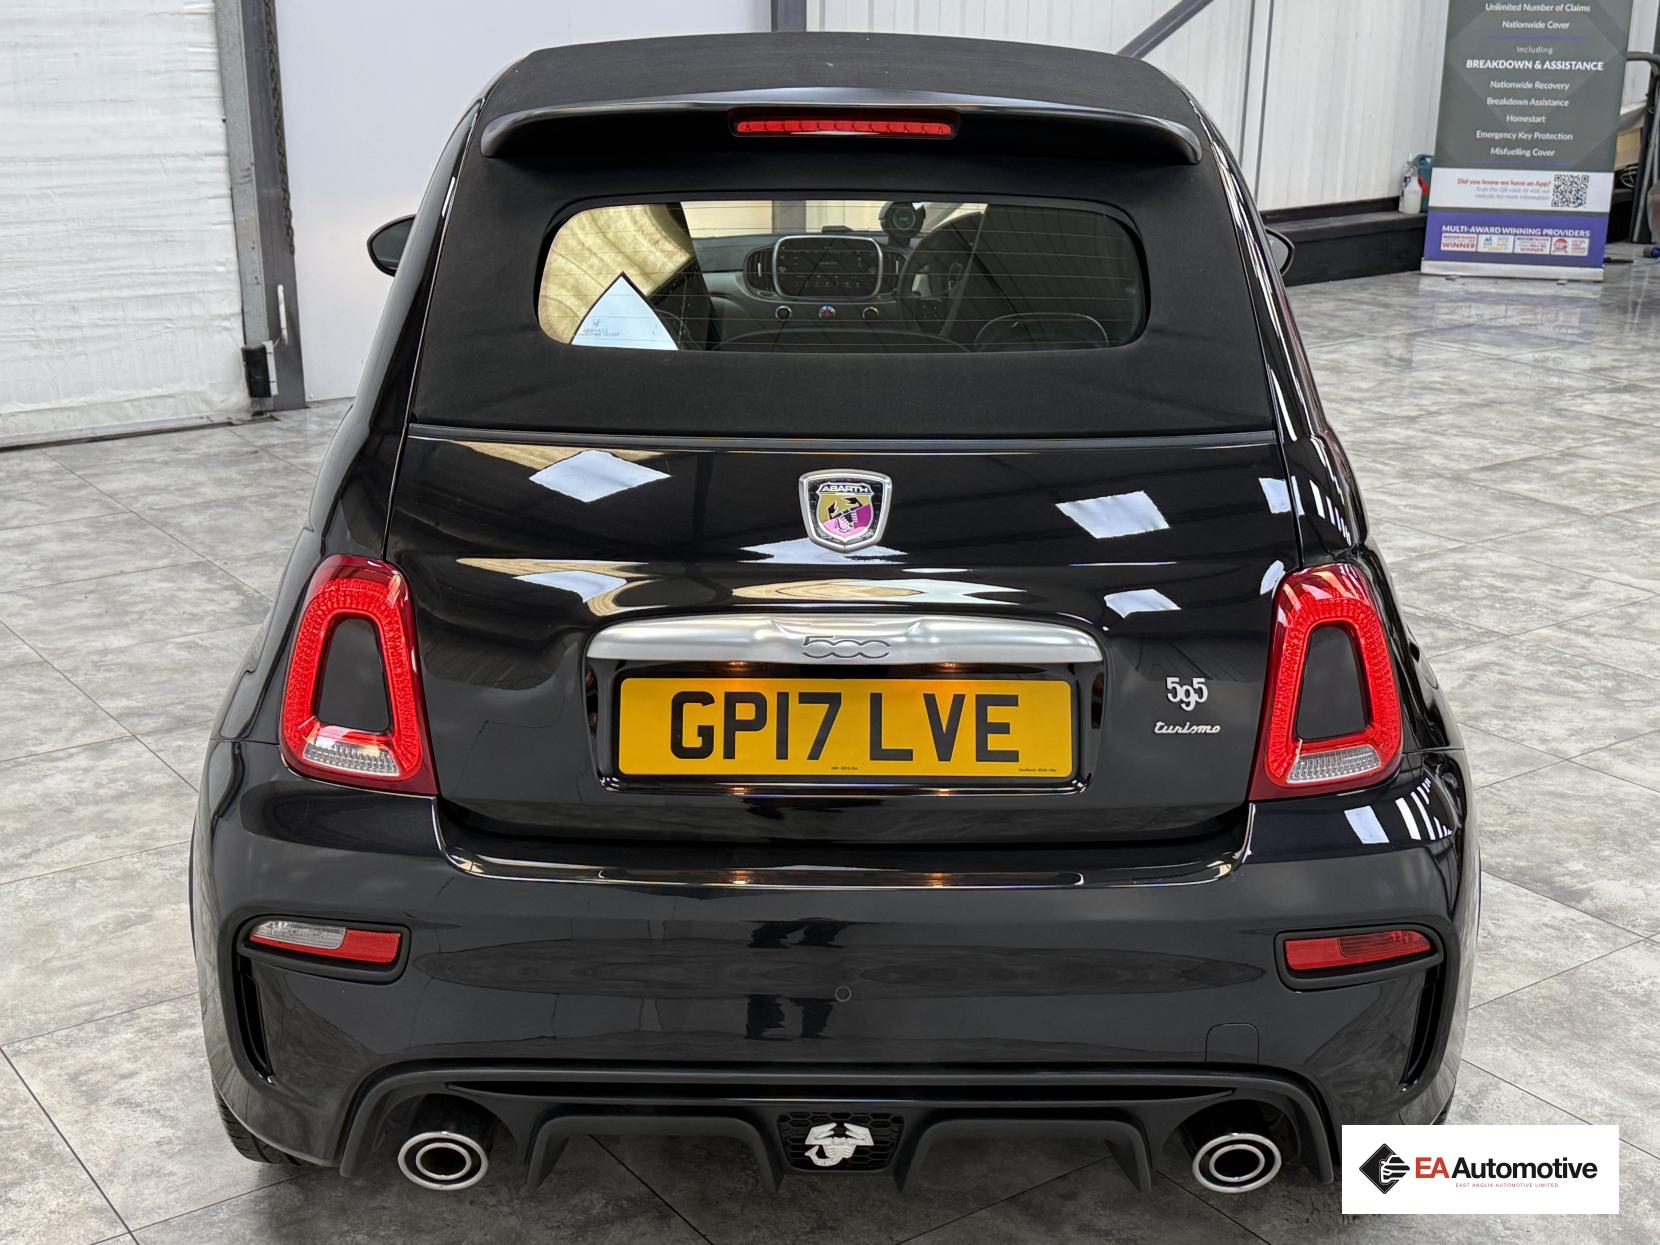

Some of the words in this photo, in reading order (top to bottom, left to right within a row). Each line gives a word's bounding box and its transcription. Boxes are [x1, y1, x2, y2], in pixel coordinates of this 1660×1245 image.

[1485, 3, 1521, 12] Unlimited
[1523, 3, 1553, 12] Number
[1555, 3, 1563, 12] of
[1565, 3, 1591, 12] Claims
[1502, 20, 1545, 29] Nationwide
[1547, 21, 1570, 29] Cover
[1466, 59, 1533, 69] BREAKDOWN
[1534, 60, 1542, 70] &
[1543, 61, 1604, 71] ASSISTANCE
[1490, 80, 1533, 89] Nationwide
[1534, 81, 1570, 91] Recovery
[1486, 97, 1528, 106] Breakdown
[1529, 98, 1569, 107] Assistance
[1506, 114, 1546, 123] Homestart
[1476, 130, 1516, 140] Emergency
[1518, 131, 1532, 141] Key
[1534, 131, 1573, 141] Protection
[1490, 147, 1531, 157] Misfuelling
[1532, 148, 1555, 157] Cover
[1535, 180, 1551, 188] App?
[1442, 225, 1501, 234] MULTI-AWARD
[1502, 226, 1541, 235] WINNING
[1542, 228, 1591, 237] PROVIDERS
[822, 485, 868, 493] ABARTH
[1166, 677, 1208, 711] 595
[670, 690, 842, 761] GP17
[869, 691, 1020, 763] LVE
[1154, 721, 1221, 734] turismo
